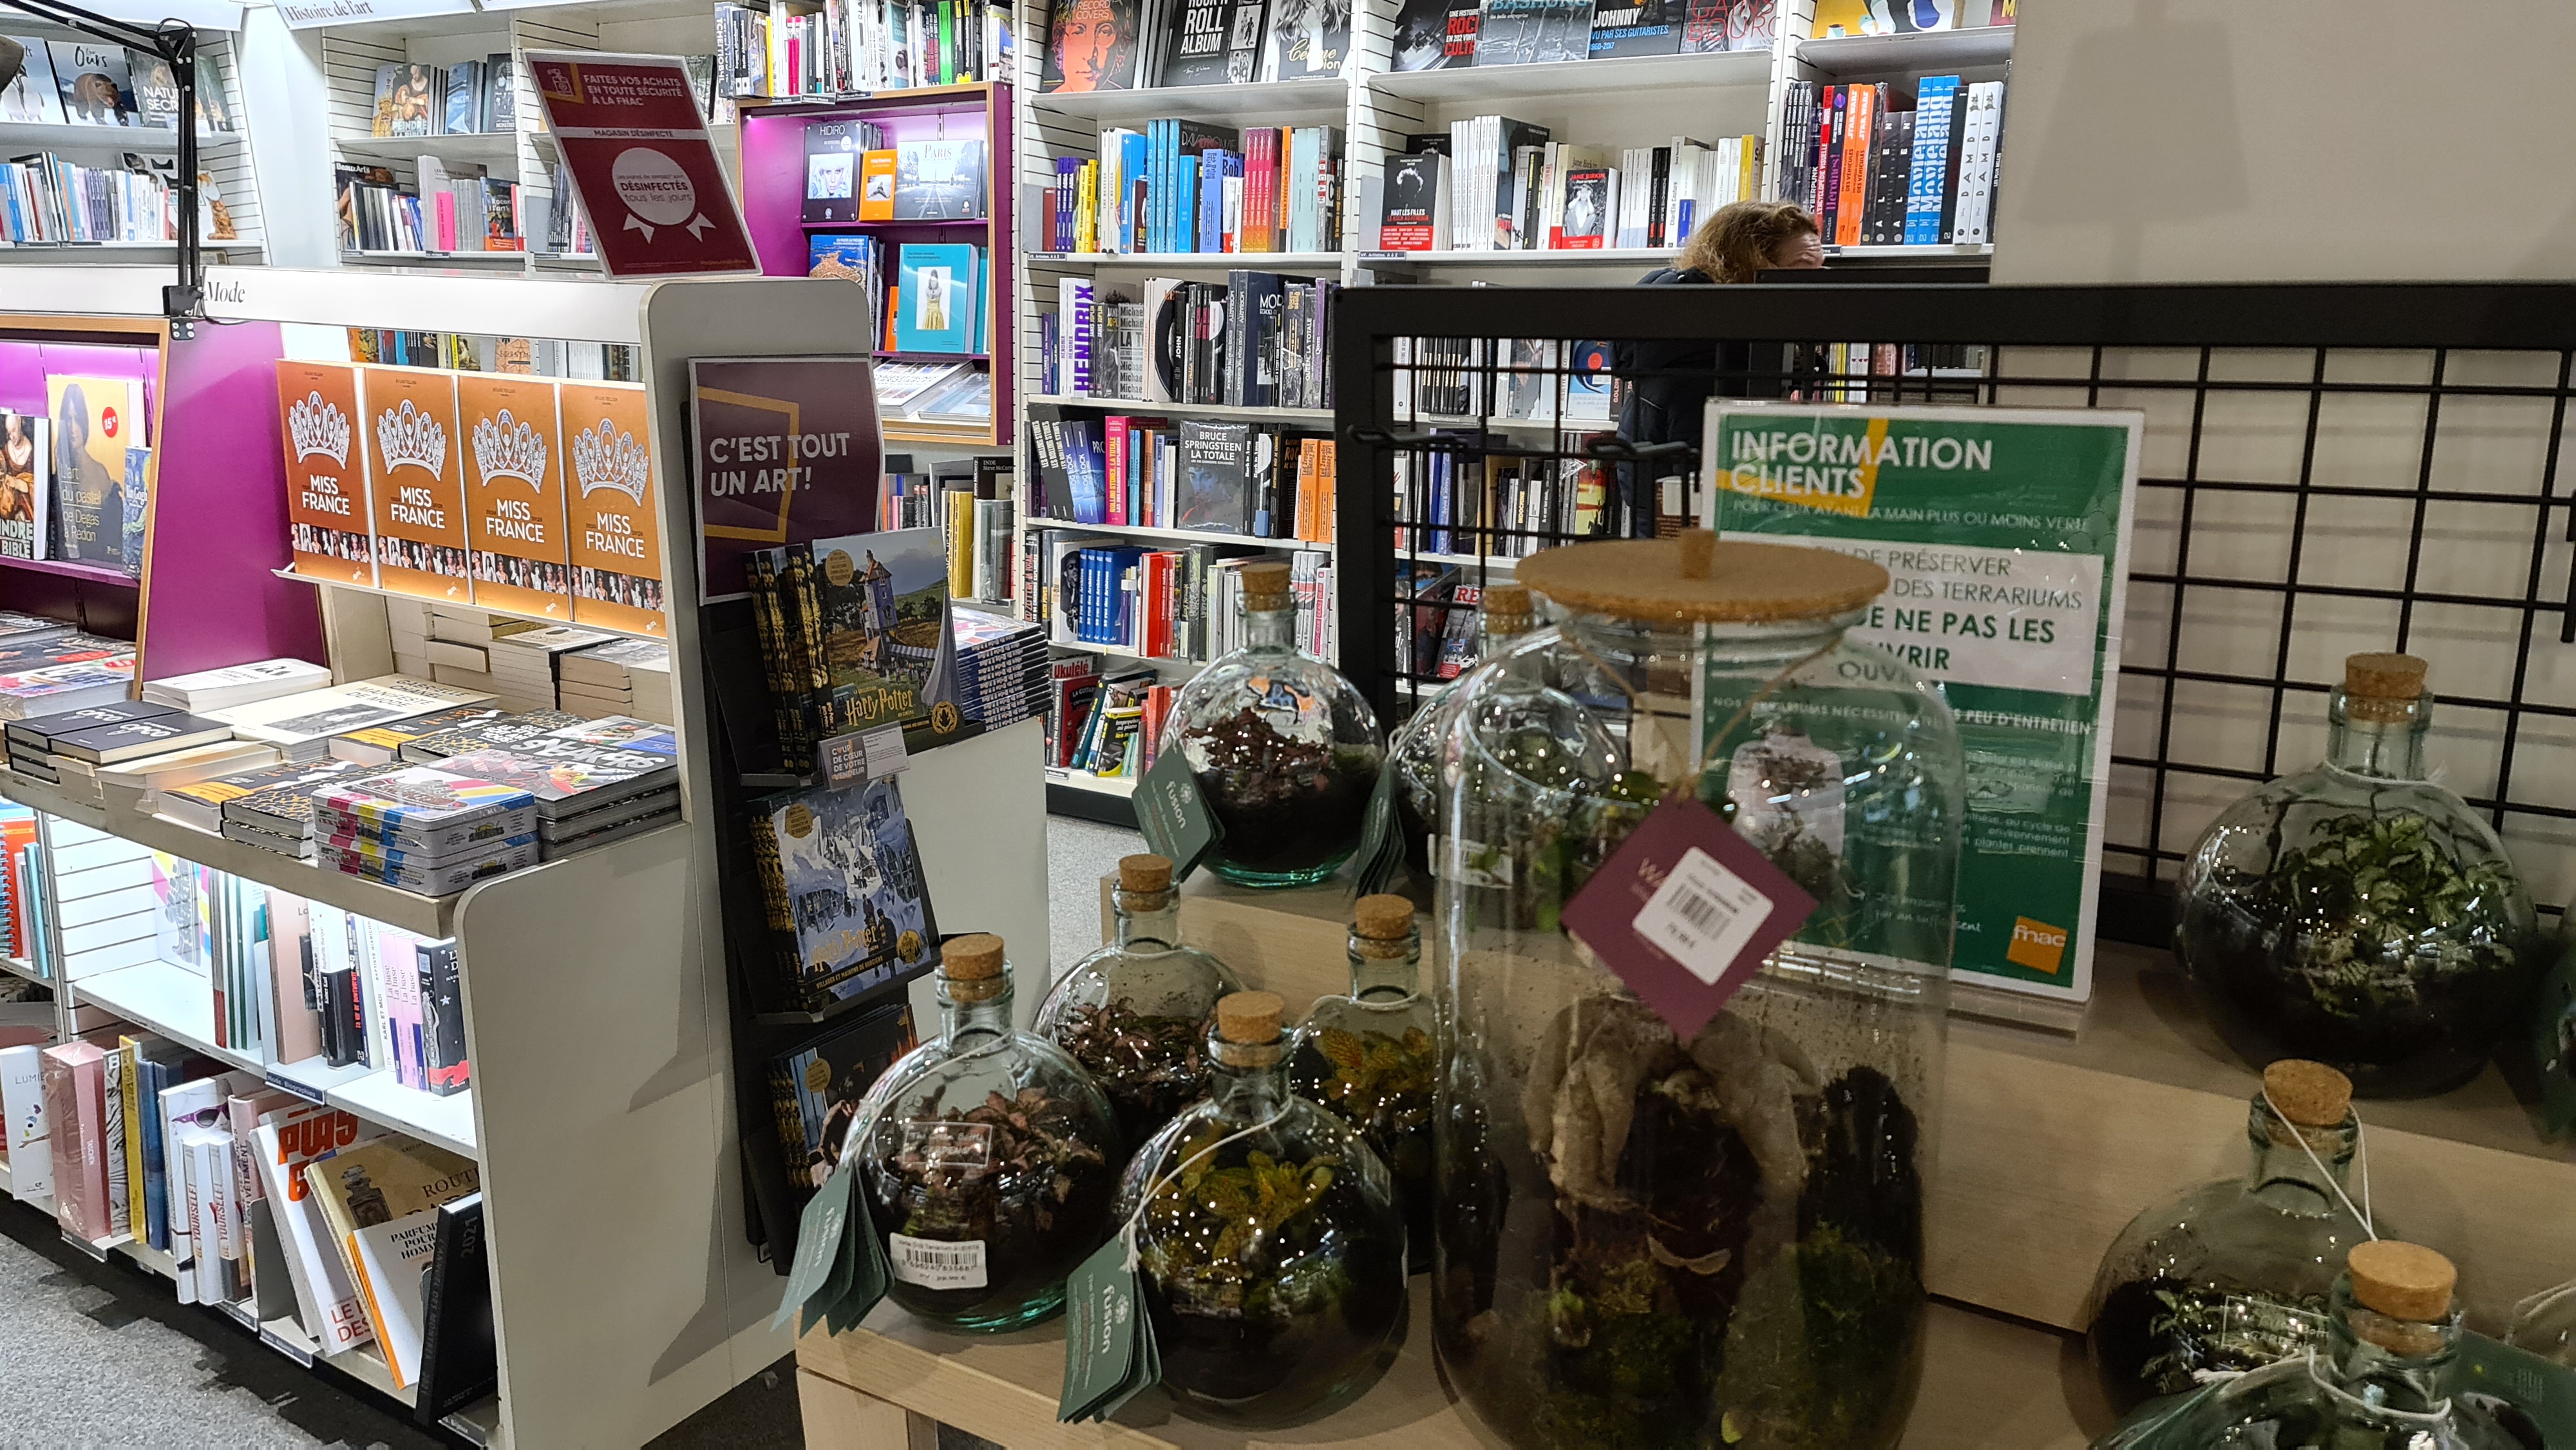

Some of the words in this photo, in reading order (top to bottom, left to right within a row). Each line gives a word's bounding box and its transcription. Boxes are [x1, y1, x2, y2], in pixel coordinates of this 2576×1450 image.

[285, 3, 334, 22] Histoire
[335, 1, 348, 17] de
[348, 0, 374, 15] l'art
[1076, 9, 1110, 19] COVERS
[1077, 0, 1110, 10] RECORD
[1184, 8, 1223, 33] ROLL
[1594, 8, 1640, 28] JOHNNY
[1591, 32, 1600, 40] VU
[1615, 29, 1627, 38] SES
[1627, 25, 1669, 37] GUITARISTES
[1180, 34, 1221, 54] ALBUM
[75, 46, 108, 67] Ours
[583, 74, 618, 85] FAITES
[619, 75, 641, 85] VOS
[643, 77, 681, 87] ACHATS
[587, 86, 601, 95] EN
[602, 86, 637, 95] TOUTE
[638, 86, 684, 97] SÉCURITÉ
[592, 95, 600, 105] À
[601, 96, 615, 105] LA
[616, 97, 644, 106] FNAC
[392, 120, 428, 131] PEINDRE
[924, 144, 952, 158] PARIS
[1908, 97, 1930, 213] Movieland
[1920, 97, 1943, 213] Movieland
[1222, 159, 1239, 176] Bob
[620, 181, 688, 192] DÉSINFECTÉS
[625, 194, 648, 202] tous
[650, 193, 664, 202] les
[668, 193, 694, 203] jours
[205, 279, 245, 303] Mode
[1075, 285, 1094, 391] HENDRIX
[1184, 440, 1242, 452] SPRINGSTEEN
[1199, 431, 1227, 441] BRUCE
[710, 435, 781, 463] C'EST
[788, 433, 850, 460] TOUT
[1191, 449, 1202, 458] LA
[1203, 451, 1235, 461] TOTALE
[1730, 430, 1993, 472] INFORMATION
[61, 465, 80, 480] L'art
[1730, 465, 1865, 498] CLIENTS
[310, 474, 339, 494] MISS
[710, 470, 746, 496] UN
[62, 489, 73, 500] du
[75, 490, 102, 505] pastel
[301, 491, 351, 516] FRANCE
[400, 485, 432, 508] MISS
[63, 511, 73, 522] de
[75, 509, 100, 527] Degas
[390, 504, 446, 529] FRANCE
[496, 498, 531, 522] MISS
[1884, 507, 1924, 522] MAIN
[1927, 508, 1960, 525] PLUS
[1964, 511, 1987, 527] OU
[1991, 513, 2041, 531] MOINS
[486, 517, 545, 543] FRANCE
[596, 511, 632, 535] MISS
[71, 527, 97, 542] Redon
[3, 541, 31, 560] BIBLE
[585, 531, 645, 560] FRANCE
[1888, 548, 2011, 576] PRÉSERVER
[1894, 577, 1934, 598] DES
[1940, 581, 2082, 610] TERRARIUMS
[1894, 607, 1931, 634] NE
[1942, 612, 1997, 639] PAS
[2008, 618, 2055, 645] LES
[1054, 659, 1090, 679] Ukulélé
[355, 686, 436, 705] MANIFESTE
[389, 685, 443, 698] CHANEL
[395, 679, 471, 697] GABRIELLE
[366, 696, 412, 708] MODE
[844, 695, 878, 727] Harry
[878, 688, 914, 722] Potter
[1965, 710, 1993, 724] PEU
[1997, 712, 2090, 735] D'ENTRETIEN
[833, 756, 842, 764] DE
[833, 764, 843, 773] DE
[844, 757, 866, 769] VOTRE
[1164, 780, 1187, 830] fusion
[2013, 924, 2067, 948] fnac
